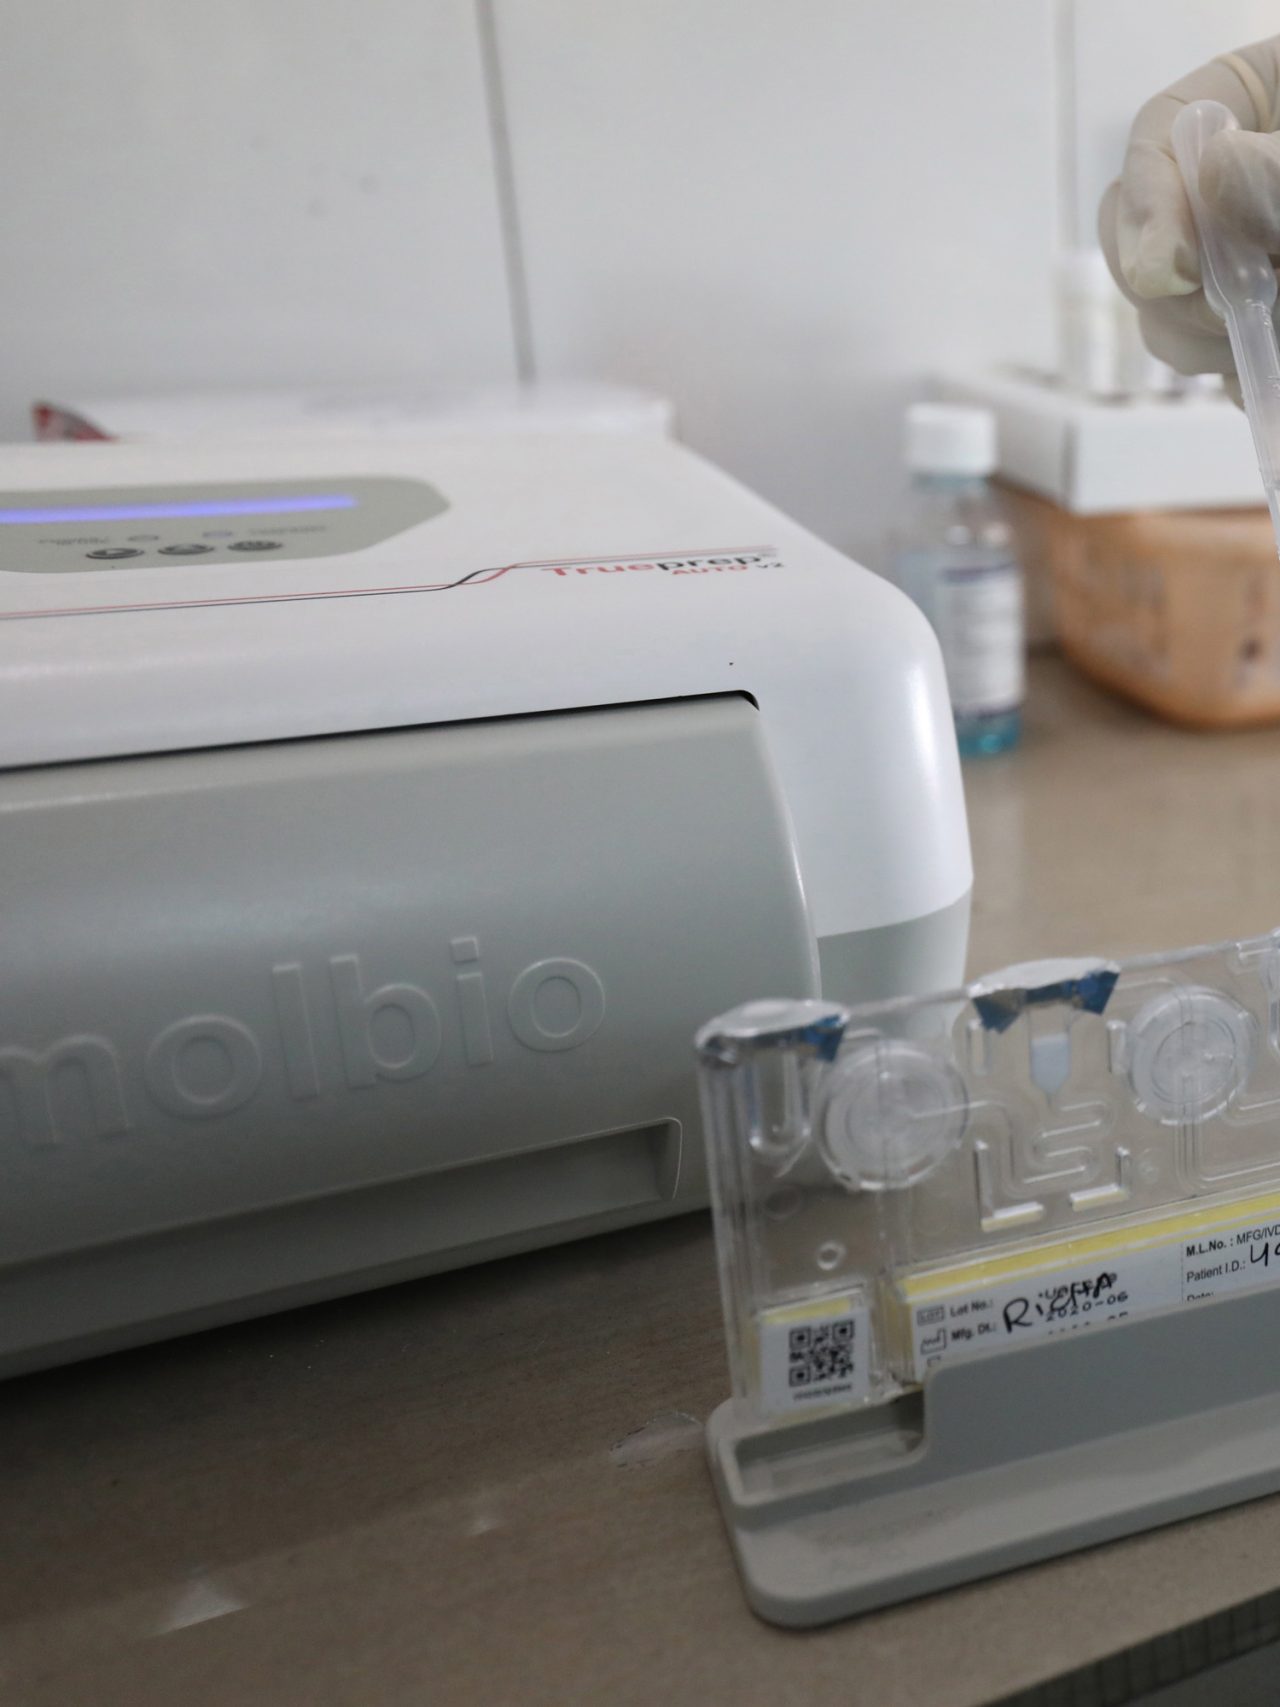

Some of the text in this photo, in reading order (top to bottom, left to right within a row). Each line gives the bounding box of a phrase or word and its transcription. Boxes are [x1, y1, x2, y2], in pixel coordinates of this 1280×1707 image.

[541, 555, 761, 576] Trueprep
[672, 564, 748, 575] AUTO
[0, 936, 606, 1150] molbio
[1186, 1265, 1223, 1283] Patient
[950, 1303, 969, 1318] Lot
